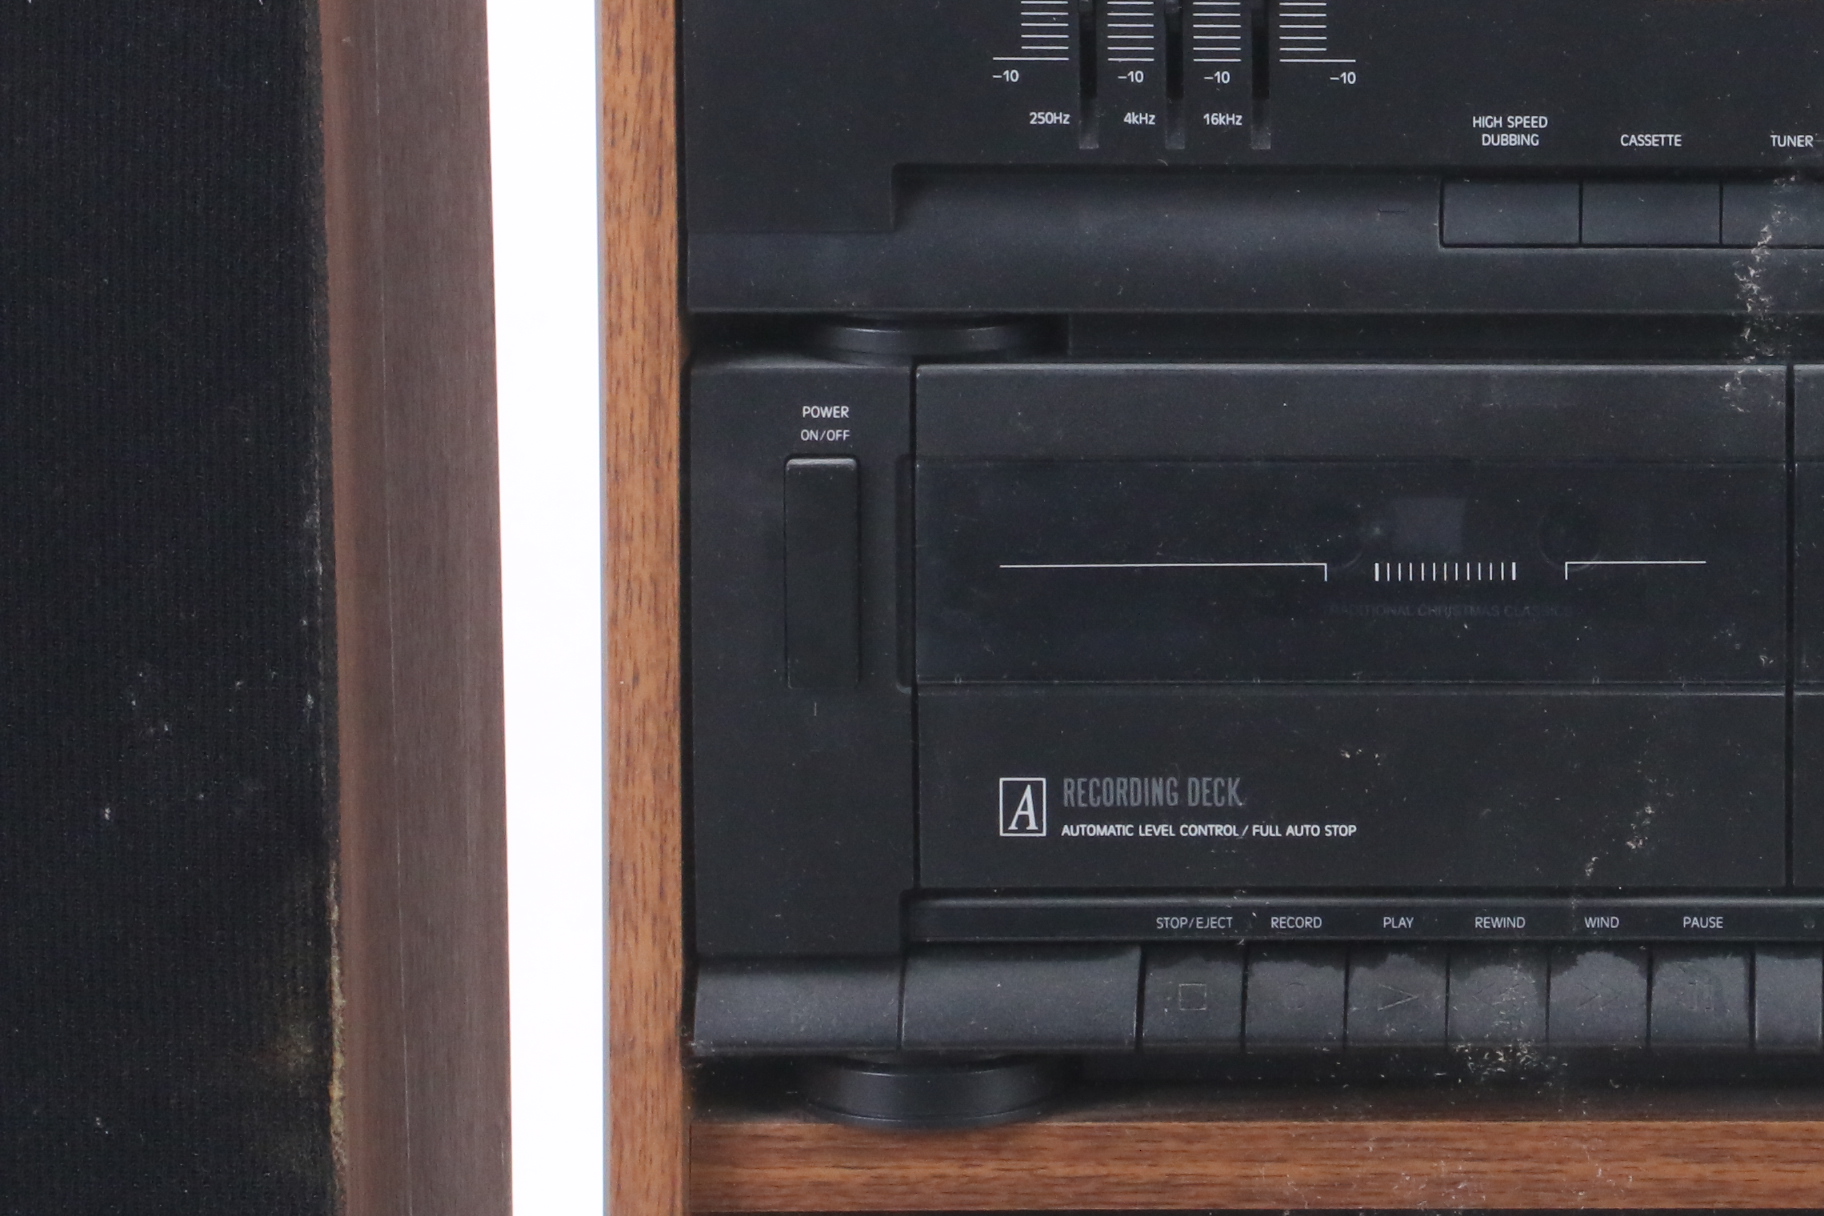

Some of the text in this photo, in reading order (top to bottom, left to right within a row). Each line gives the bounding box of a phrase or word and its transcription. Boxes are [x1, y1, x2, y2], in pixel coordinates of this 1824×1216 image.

[1030, 112, 1070, 124] 250Hz
[1124, 112, 1155, 124] 4kHz
[1204, 113, 1242, 125] 16kHz
[1473, 116, 1548, 128] HIGH SPEED
[1482, 134, 1539, 146] DUBBING
[1621, 134, 1681, 146] CASSETTE
[1770, 135, 1813, 147] TUNER
[803, 406, 849, 418] POWER
[801, 429, 850, 441] ON/OFF
[1064, 777, 1242, 807] RECORDING DECK
[1008, 785, 1038, 830] A
[1061, 824, 1134, 836] AUTOMATIC
[1139, 824, 1175, 836] LEVEL
[1180, 824, 1239, 836] CONTROL
[1253, 825, 1282, 836] FULL
[1286, 825, 1320, 836] AUTO
[1325, 825, 1357, 836] STOP
[1157, 917, 1232, 929] STOP/EJECT
[1271, 917, 1322, 928] RECORD
[1384, 917, 1413, 928] PLAY
[1475, 917, 1525, 928] REWIND
[1585, 917, 1619, 928] WIND
[1683, 917, 1723, 928] PAUSE
